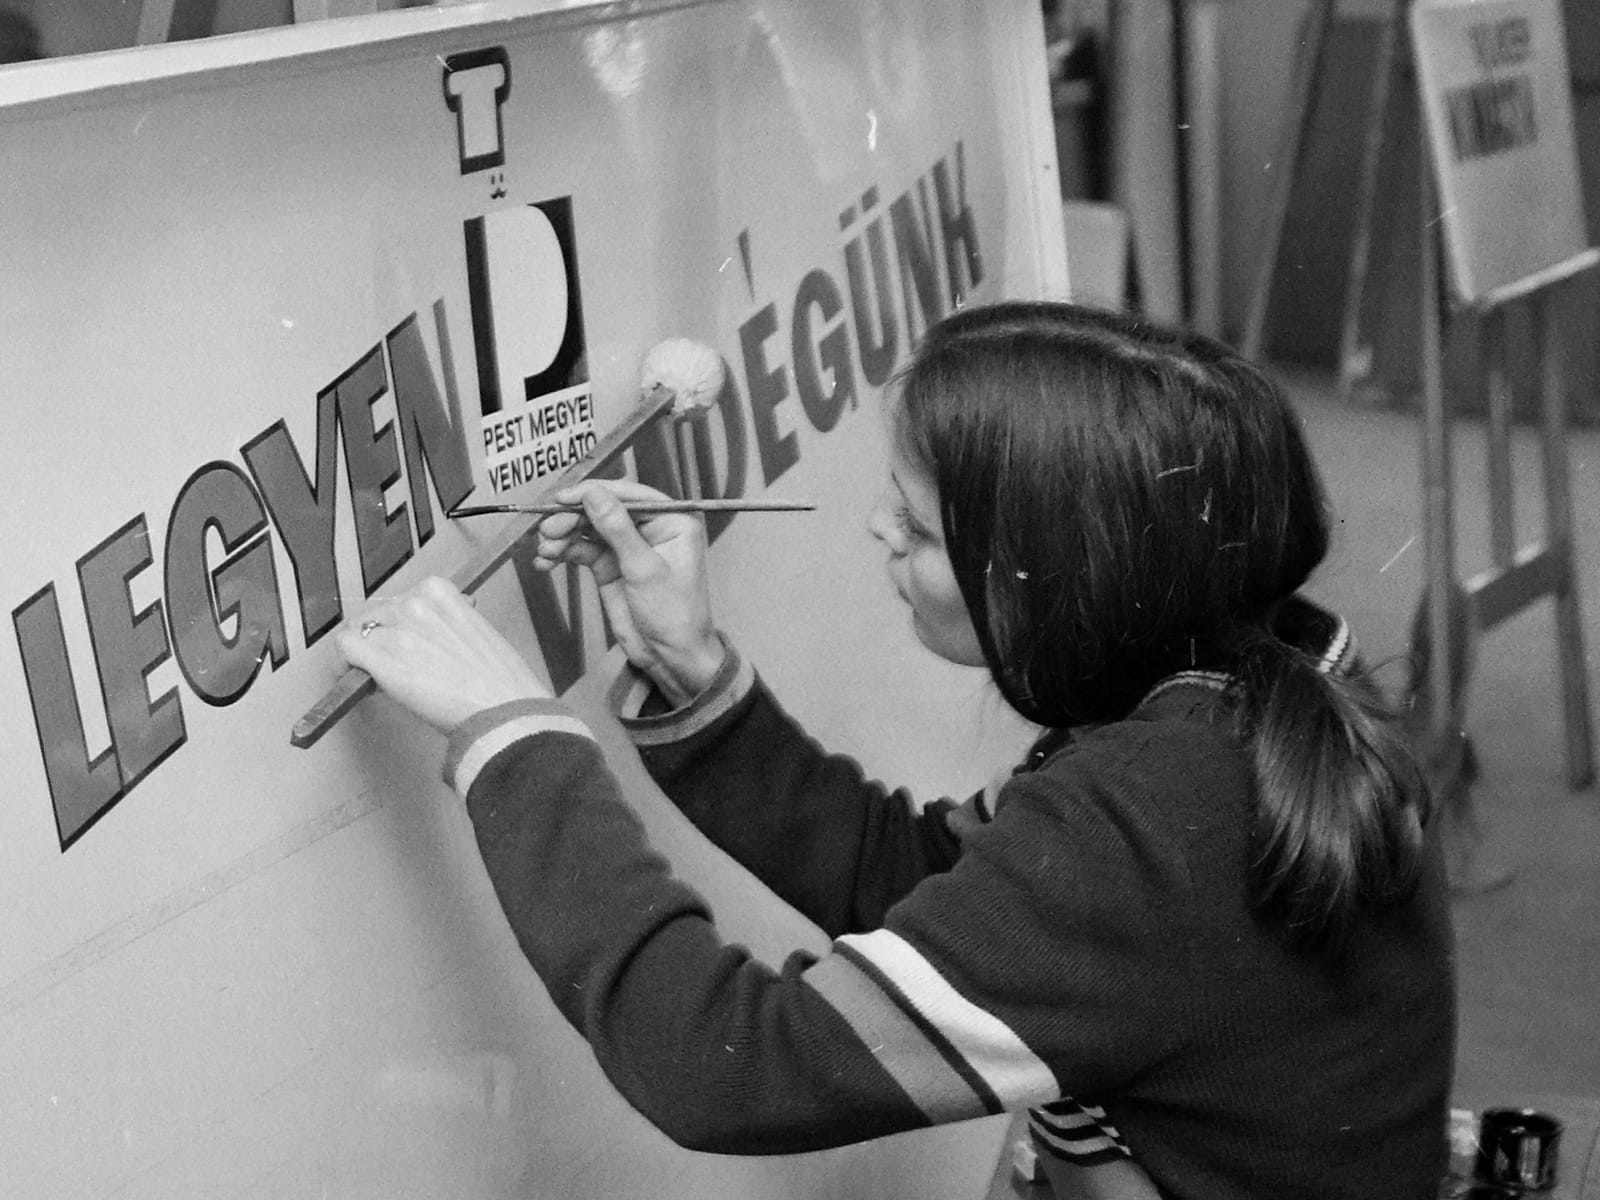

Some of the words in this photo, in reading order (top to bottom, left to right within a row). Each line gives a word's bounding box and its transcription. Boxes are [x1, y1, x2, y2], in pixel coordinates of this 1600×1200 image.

[484, 416, 523, 456] PEST
[529, 392, 594, 441] MEGYEI
[489, 423, 598, 495] VENDÉGLÁTÓ
[11, 296, 476, 853] LEGYEN
